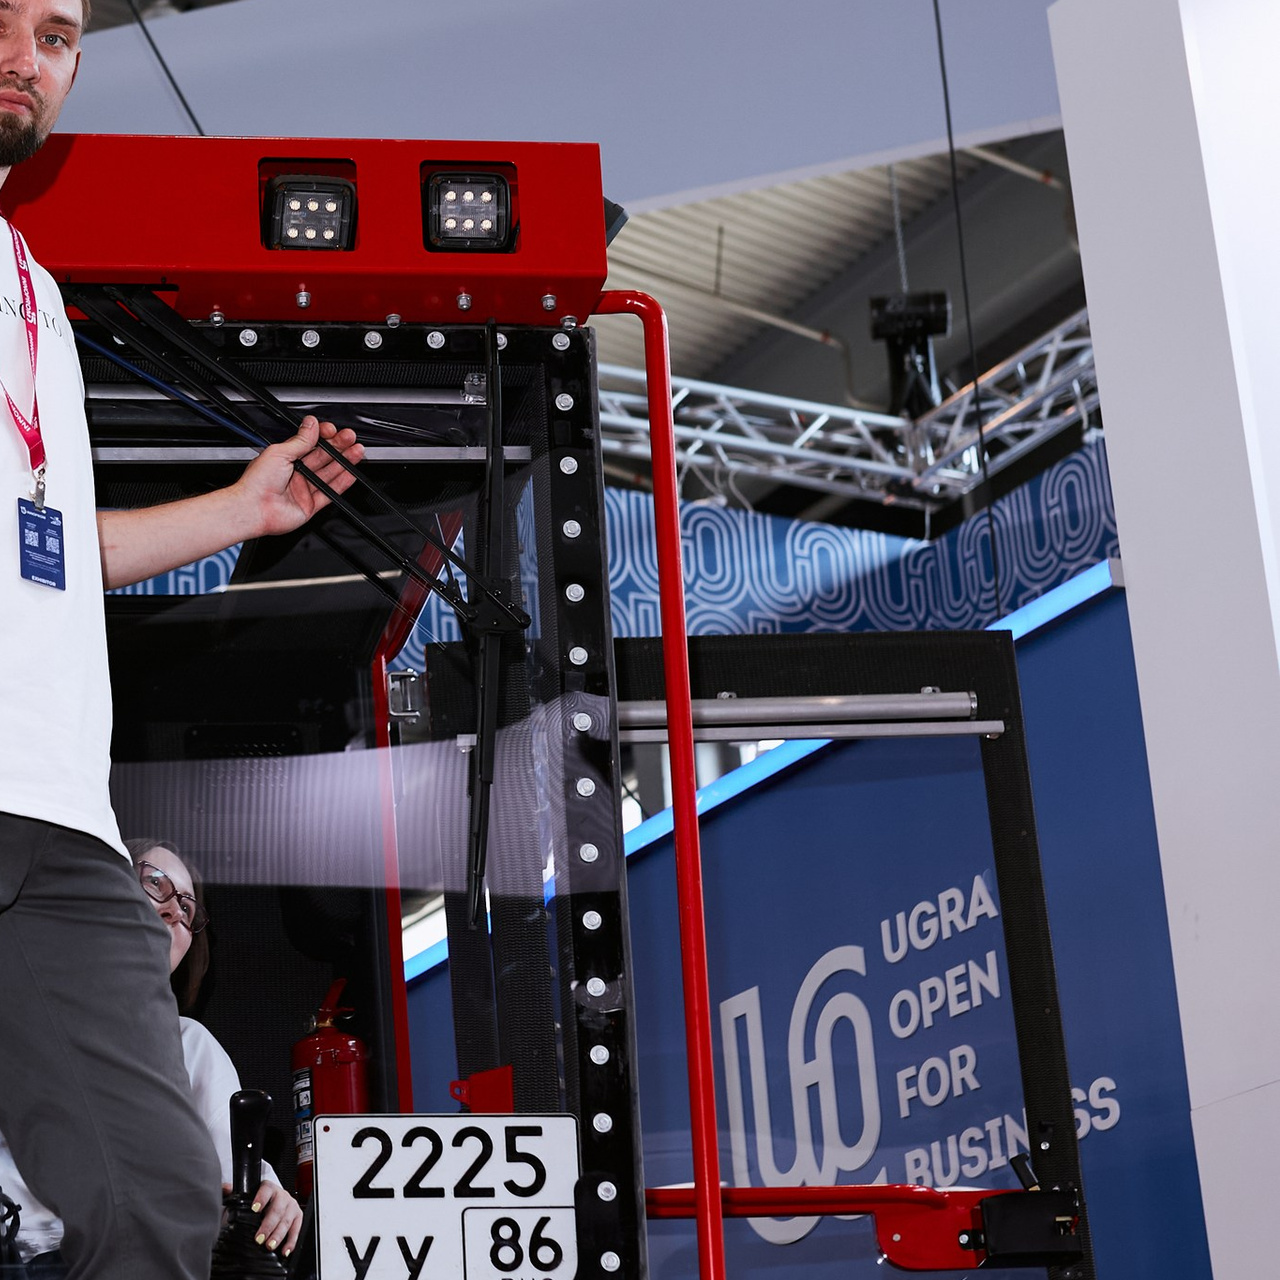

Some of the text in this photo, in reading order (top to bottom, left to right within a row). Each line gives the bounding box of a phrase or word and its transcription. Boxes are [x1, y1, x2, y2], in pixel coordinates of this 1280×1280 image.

[880, 874, 1000, 964] UGRA
[888, 950, 1002, 1040] OPEN
[895, 1044, 982, 1119] FOR
[350, 1125, 547, 1199] 2225
[904, 1076, 1121, 1188] BUSINSS
[489, 1215, 564, 1272] 86
